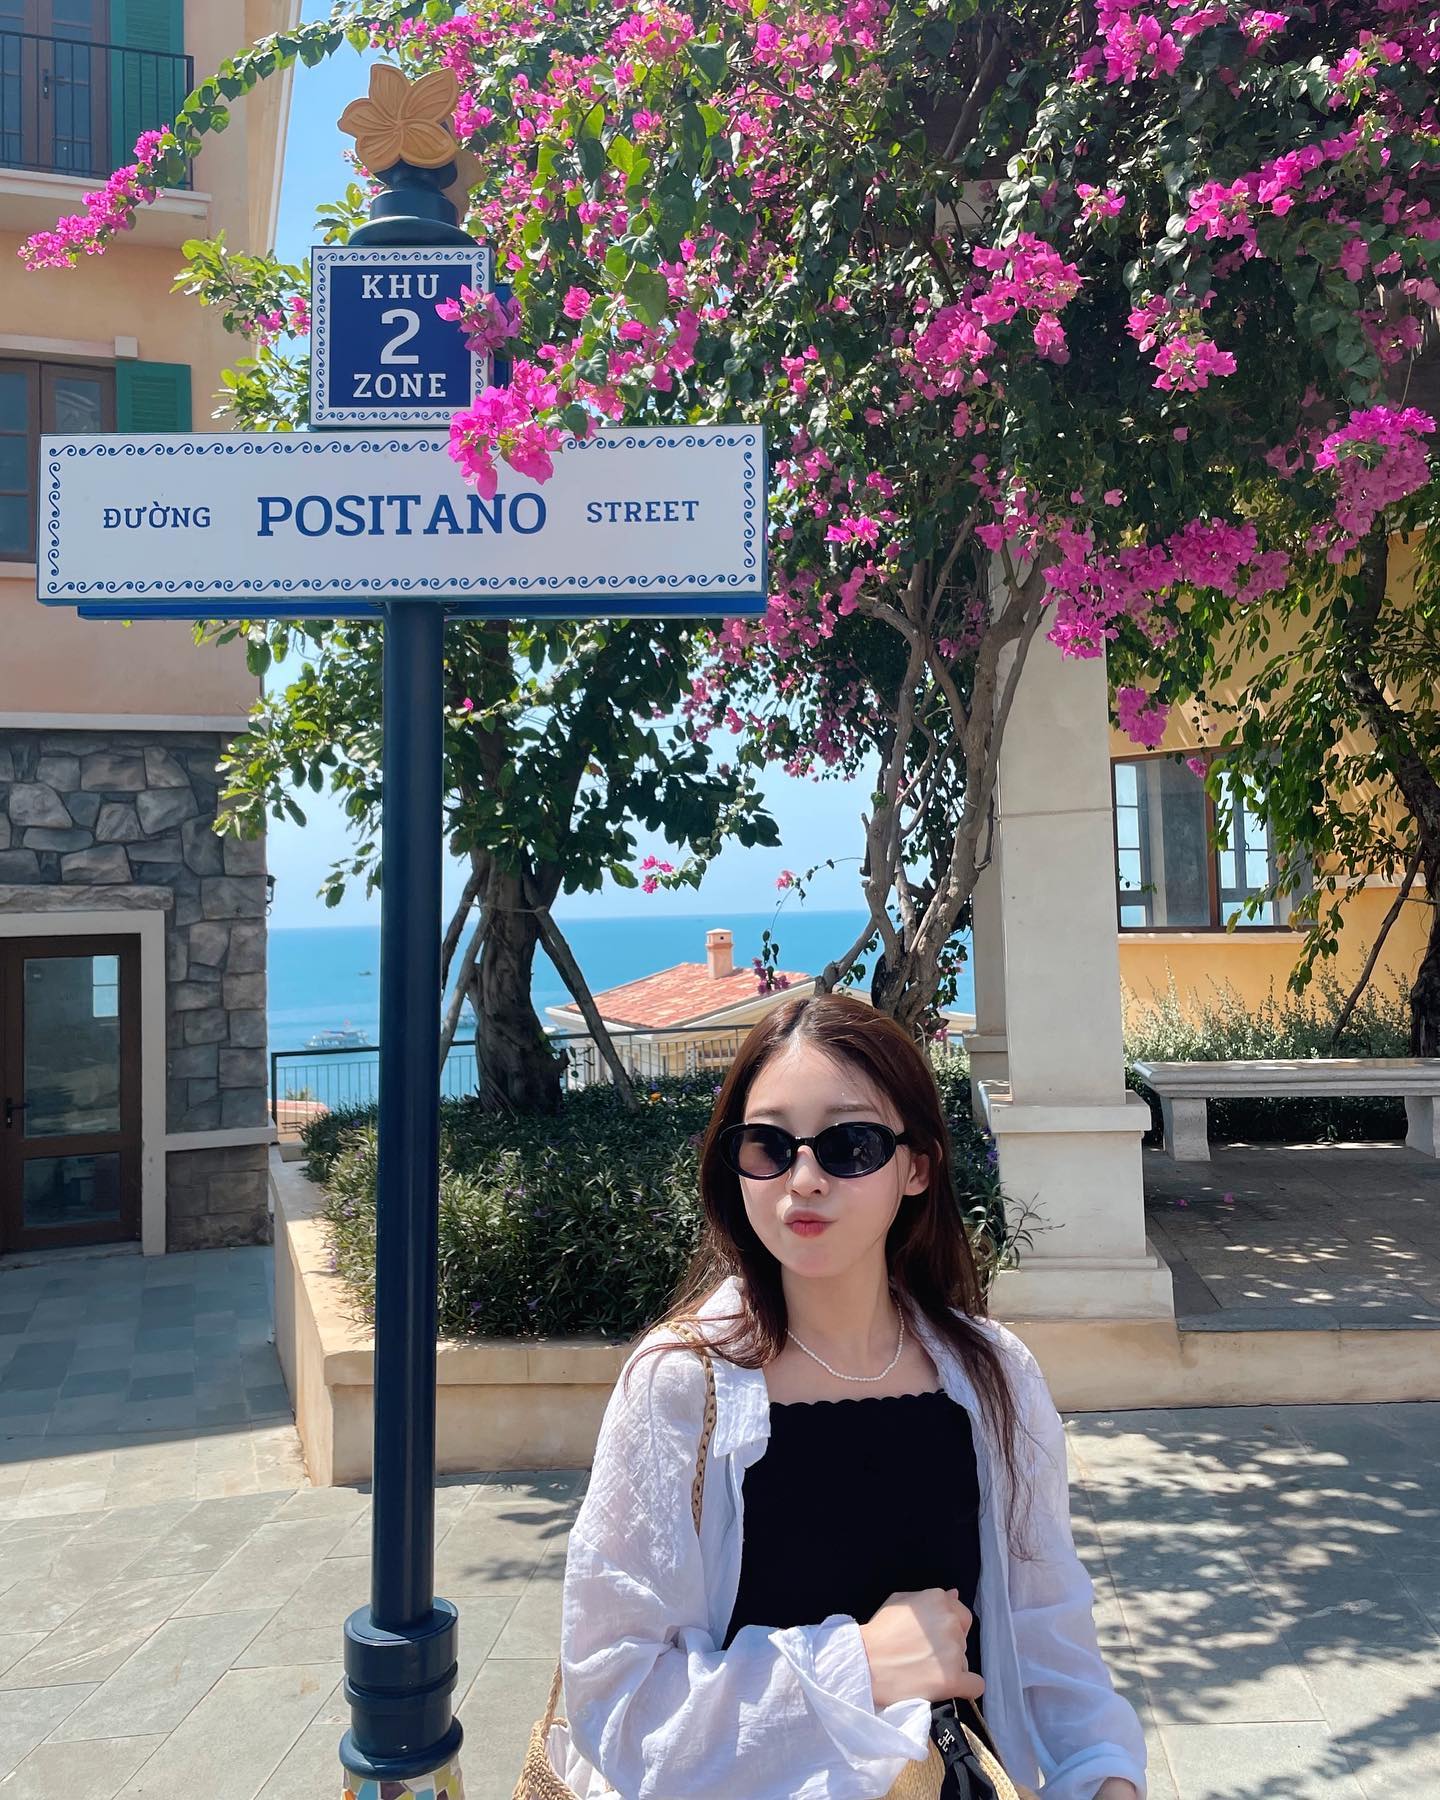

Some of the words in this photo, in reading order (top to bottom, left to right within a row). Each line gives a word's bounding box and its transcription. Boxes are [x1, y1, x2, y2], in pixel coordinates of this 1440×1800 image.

[361, 274, 440, 300] KHU
[380, 308, 421, 365] 2
[352, 373, 447, 399] ZONE
[103, 501, 211, 528] ĐƯỜNG
[257, 492, 547, 537] POSITANO
[586, 500, 700, 523] STREET
